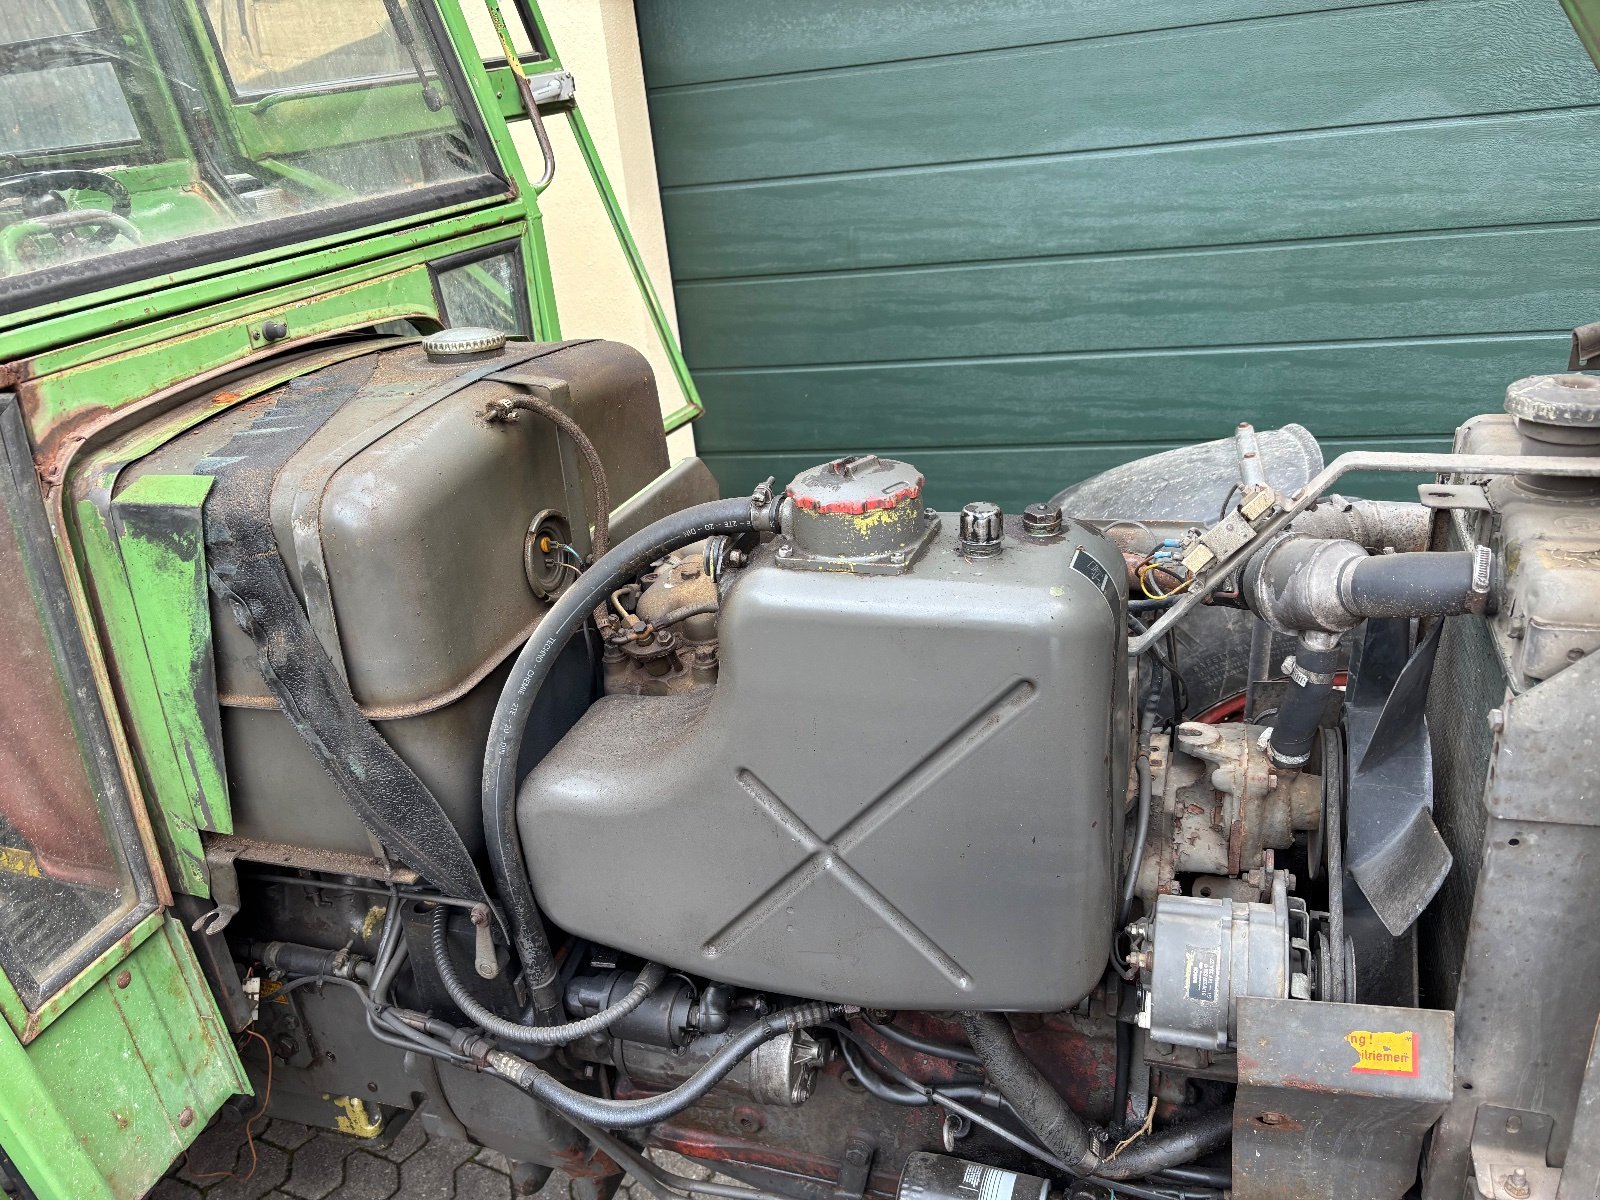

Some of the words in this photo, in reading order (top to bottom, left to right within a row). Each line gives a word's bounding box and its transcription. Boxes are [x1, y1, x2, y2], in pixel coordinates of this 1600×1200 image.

[704, 523, 715, 531] 20
[723, 520, 738, 528] 2TE
[683, 527, 697, 538] DIN
[535, 636, 557, 663] TECHNO
[517, 668, 535, 696] CHEMIE
[1359, 1049, 1410, 1062] ilriemen
